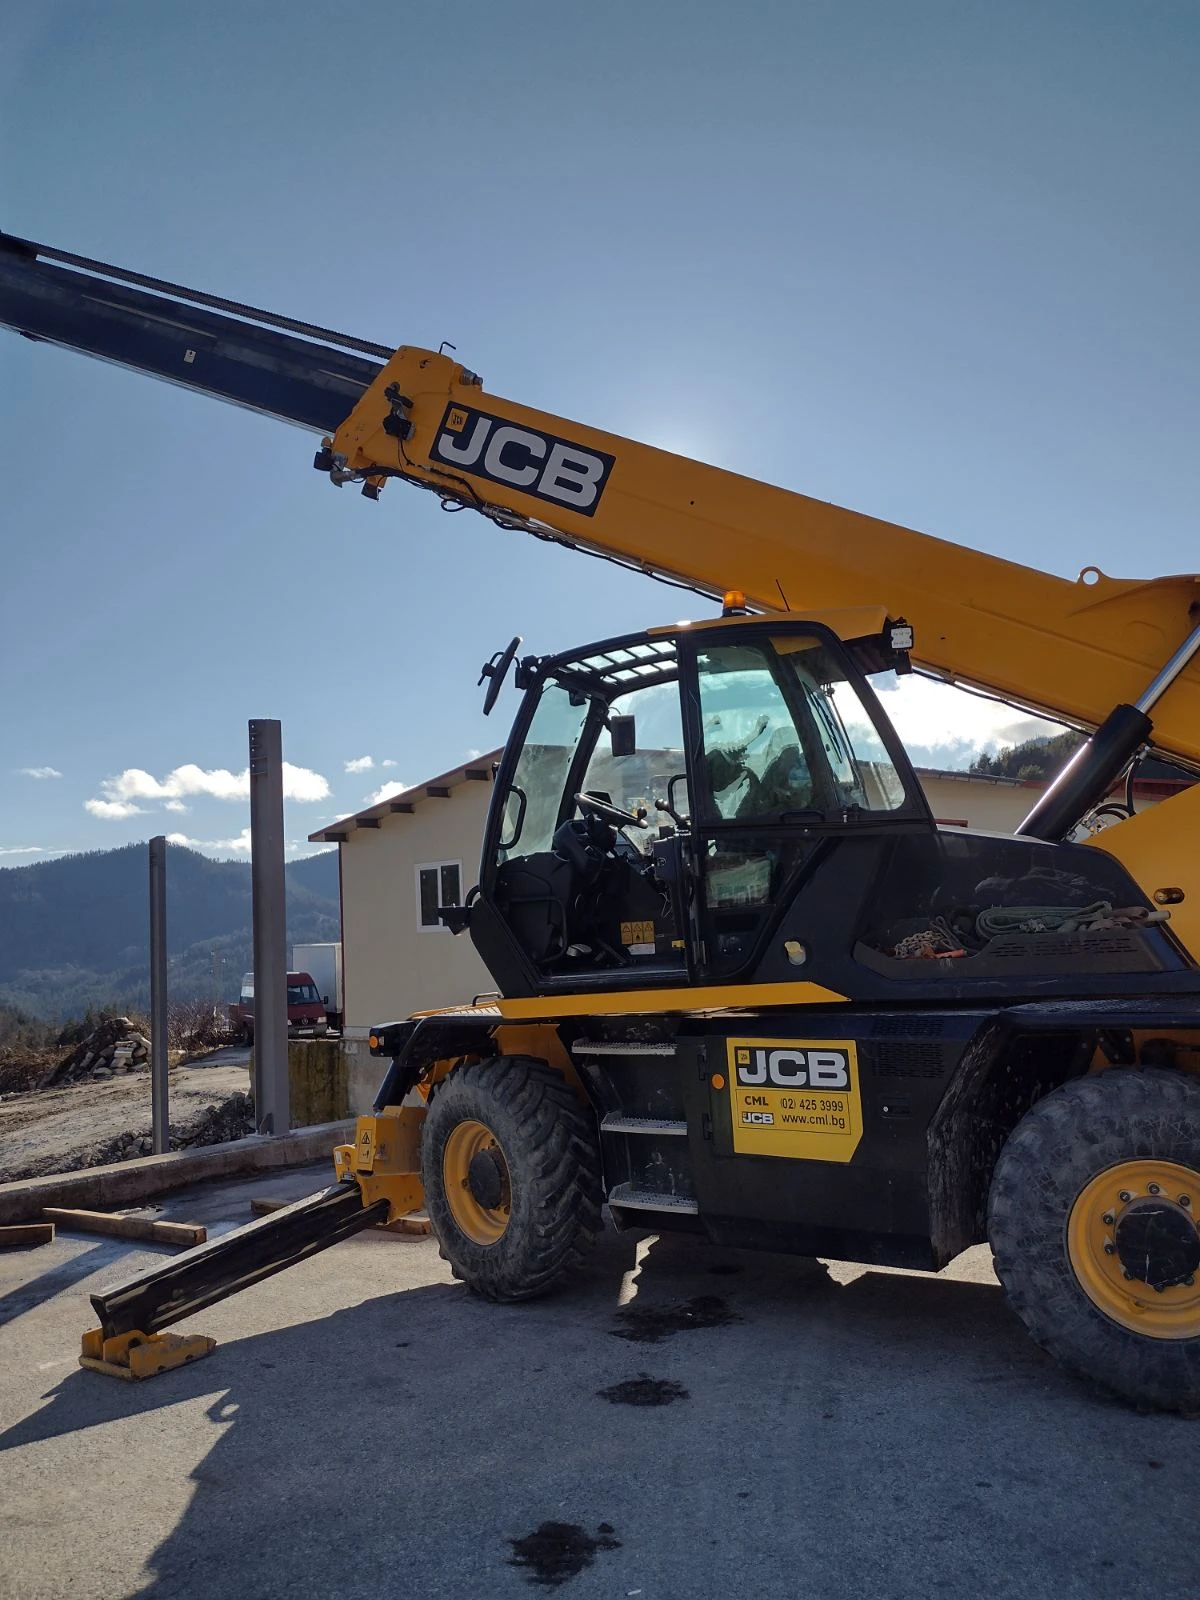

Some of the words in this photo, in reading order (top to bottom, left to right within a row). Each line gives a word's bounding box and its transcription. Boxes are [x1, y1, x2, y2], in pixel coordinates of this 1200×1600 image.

[438, 417, 604, 507] JCB
[738, 1050, 848, 1087] JCB
[744, 1096, 769, 1106] CML
[780, 1098, 797, 1110] (02)
[799, 1099, 817, 1111] 425
[820, 1100, 844, 1112] 3999
[743, 1112, 774, 1124] JCB
[782, 1114, 846, 1129] www.cml.bg
